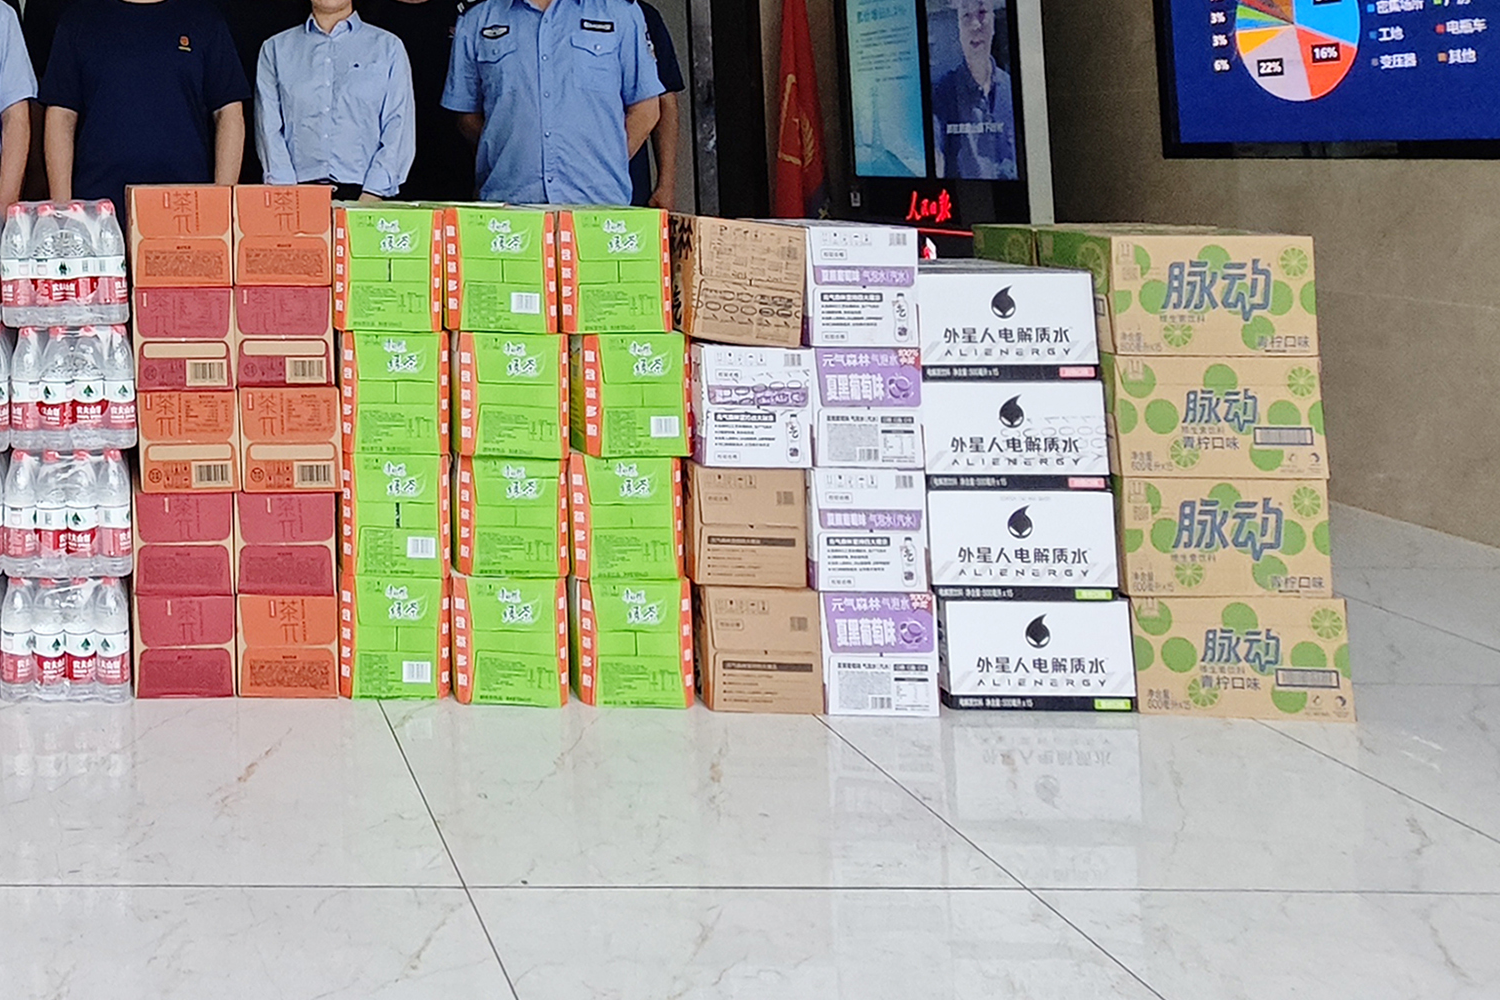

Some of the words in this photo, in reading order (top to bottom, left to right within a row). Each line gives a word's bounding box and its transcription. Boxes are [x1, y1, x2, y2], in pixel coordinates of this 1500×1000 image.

[1210, 12, 1226, 24] 3%
[1212, 34, 1228, 46] 3%
[1378, 26, 1404, 42] 工地
[1313, 46, 1338, 59] 16%
[1214, 59, 1230, 71] 6%
[1259, 61, 1282, 74] 22%
[1161, 258, 1272, 322] 脉动
[944, 327, 1070, 343] 外星人电解质水
[944, 348, 1071, 356] ALIENERGY
[1182, 388, 1258, 432] 脉动
[950, 436, 1079, 453] 外星人电解质水
[951, 458, 1080, 466] ALIENERGY
[1172, 497, 1283, 561] 脉动
[958, 547, 1088, 564] 外星人电解质水
[958, 569, 1089, 577] ALIENERGY
[1200, 629, 1280, 672] 脉动
[977, 657, 1105, 674] 外星人电解质水
[977, 678, 1106, 687] ALIENERGY
